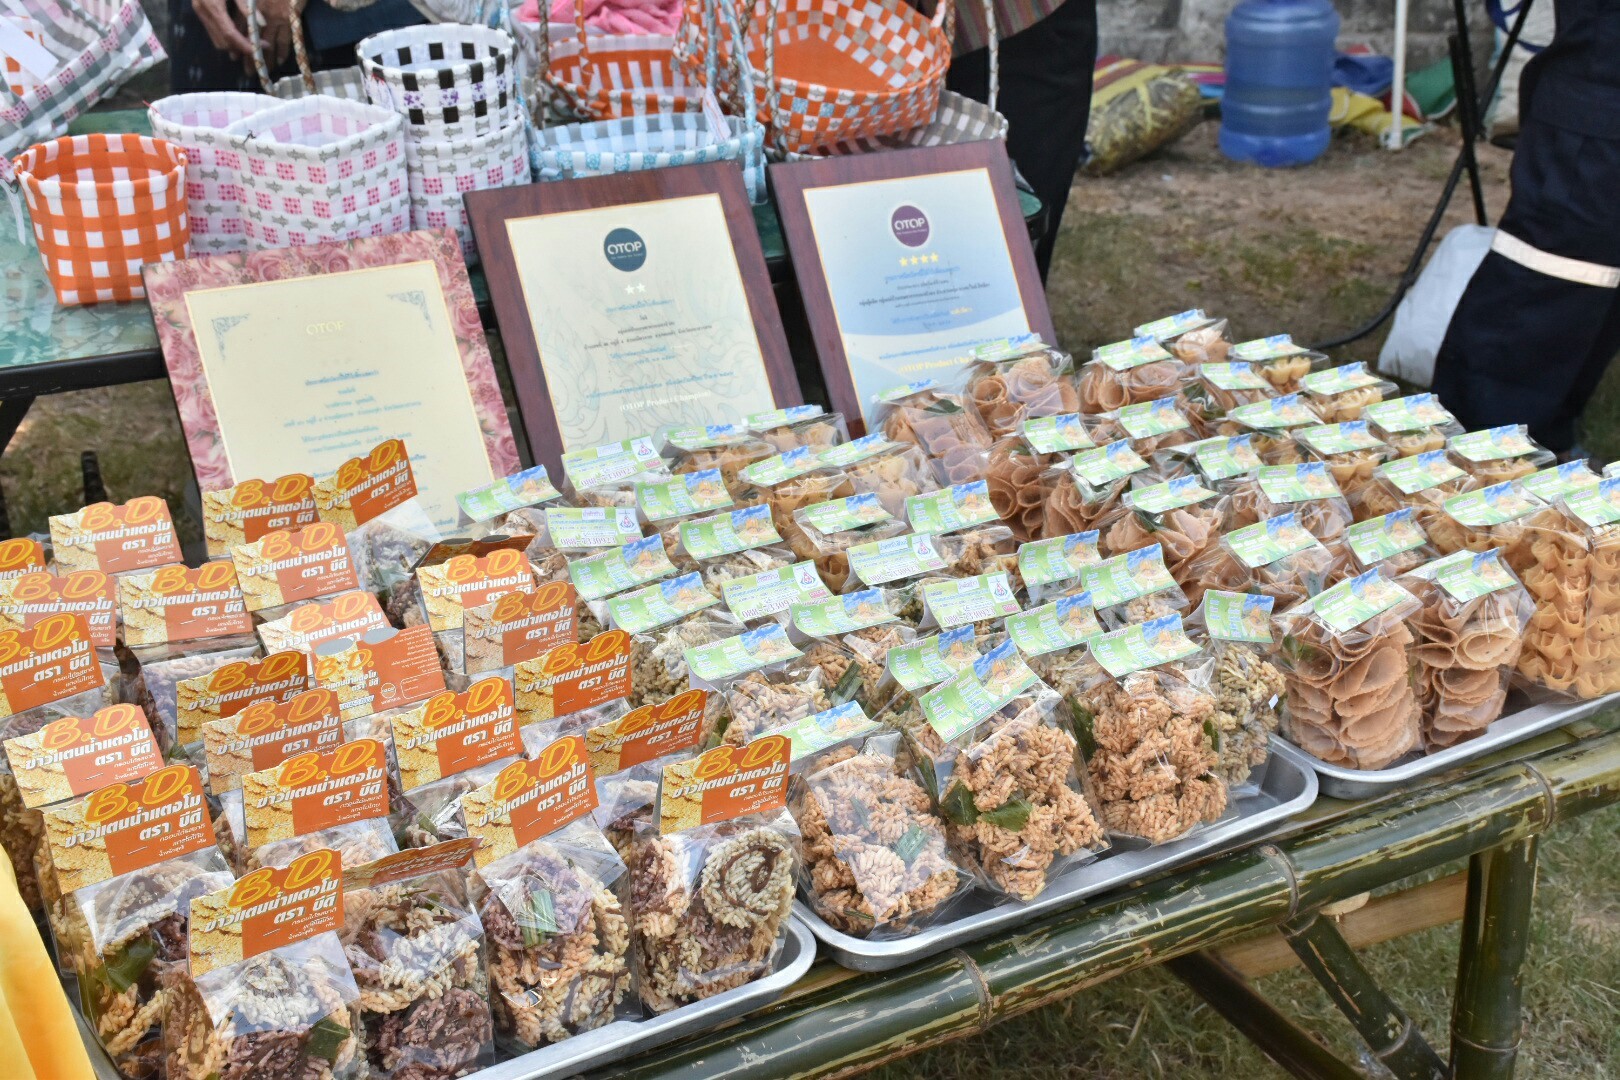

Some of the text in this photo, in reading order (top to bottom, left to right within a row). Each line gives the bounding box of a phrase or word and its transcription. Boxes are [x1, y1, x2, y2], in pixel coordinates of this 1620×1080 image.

[894, 217, 925, 231] OTOP
[607, 241, 642, 255] OTOP
[337, 438, 401, 490] B.D.
[230, 474, 309, 508] B.D.
[371, 483, 391, 499] ตรา
[80, 496, 165, 532] B.D.
[268, 516, 290, 529] ตรา
[122, 539, 146, 552] ตรา
[260, 521, 340, 561] B.D.
[149, 562, 241, 594] B.D.
[302, 565, 325, 579] ตรา
[445, 547, 524, 582] B.D.
[12, 570, 108, 602] B.D.
[492, 580, 569, 622] B.D.
[191, 606, 216, 618] ตรา
[290, 590, 374, 634] B.D.
[526, 625, 549, 641] ตรา
[542, 630, 625, 675] B.D.
[33, 665, 62, 684] ตรา
[208, 651, 302, 694] B.D.
[578, 674, 603, 691] ตรา
[237, 687, 332, 735] B.D.
[424, 677, 505, 731] B.D.
[615, 688, 702, 736] B.D.
[40, 703, 140, 751] B.D.
[462, 729, 488, 748] ตรา
[647, 731, 673, 746] ตรา
[94, 751, 125, 768] ตรา
[281, 738, 310, 754] ตรา
[693, 735, 784, 780] B.D.
[279, 738, 378, 789] B.D.
[492, 736, 579, 802] B.D.
[84, 764, 194, 825] B.D.
[322, 790, 352, 807] ตรา
[536, 791, 563, 813] ตรา
[729, 782, 756, 799] ตรา
[139, 821, 171, 843] ตรา
[228, 849, 334, 910] B.D.
[273, 905, 305, 926] ตรา
